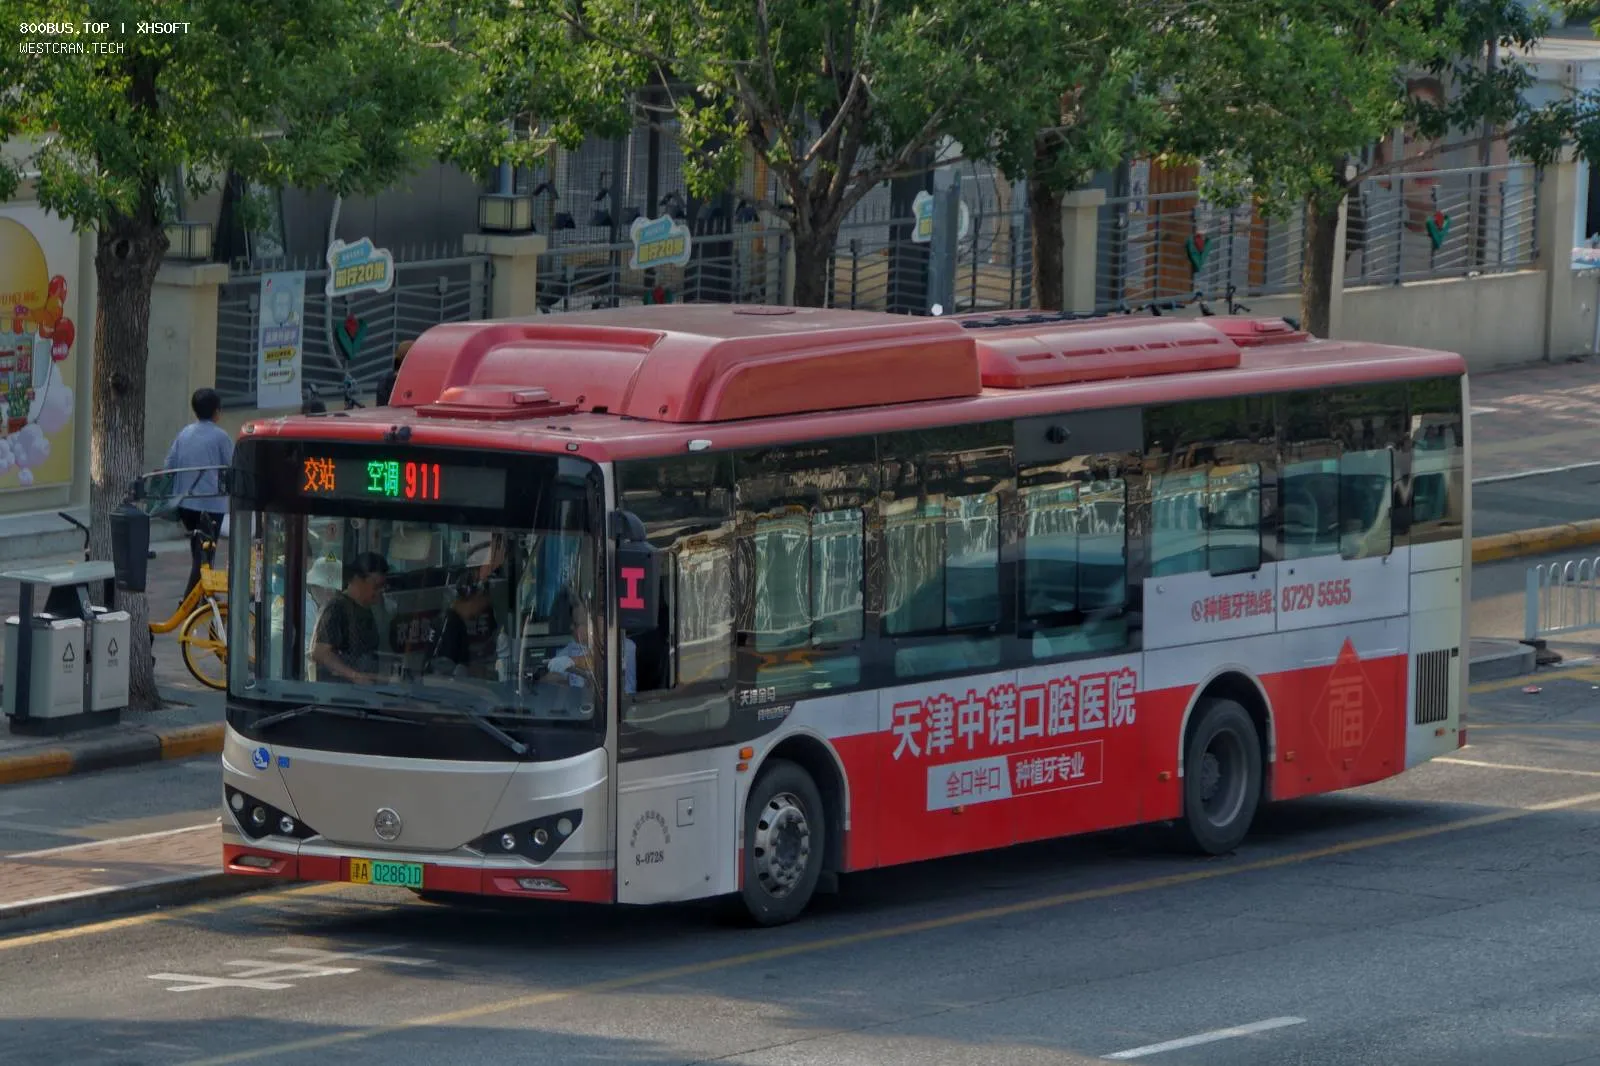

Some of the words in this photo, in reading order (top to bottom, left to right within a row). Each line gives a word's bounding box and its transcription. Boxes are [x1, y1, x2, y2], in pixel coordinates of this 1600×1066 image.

[303, 456, 336, 492] 交站
[367, 460, 400, 497] 空调
[405, 462, 441, 500] 911
[1281, 583, 1314, 613] 8729
[1317, 578, 1352, 608] 5555
[892, 667, 1137, 760] 天津中诺口腔医院
[1328, 675, 1364, 749] 福
[945, 767, 1001, 799] 全口半口
[1014, 751, 1086, 789] 种植牙专业
[635, 850, 665, 867] 8-0728
